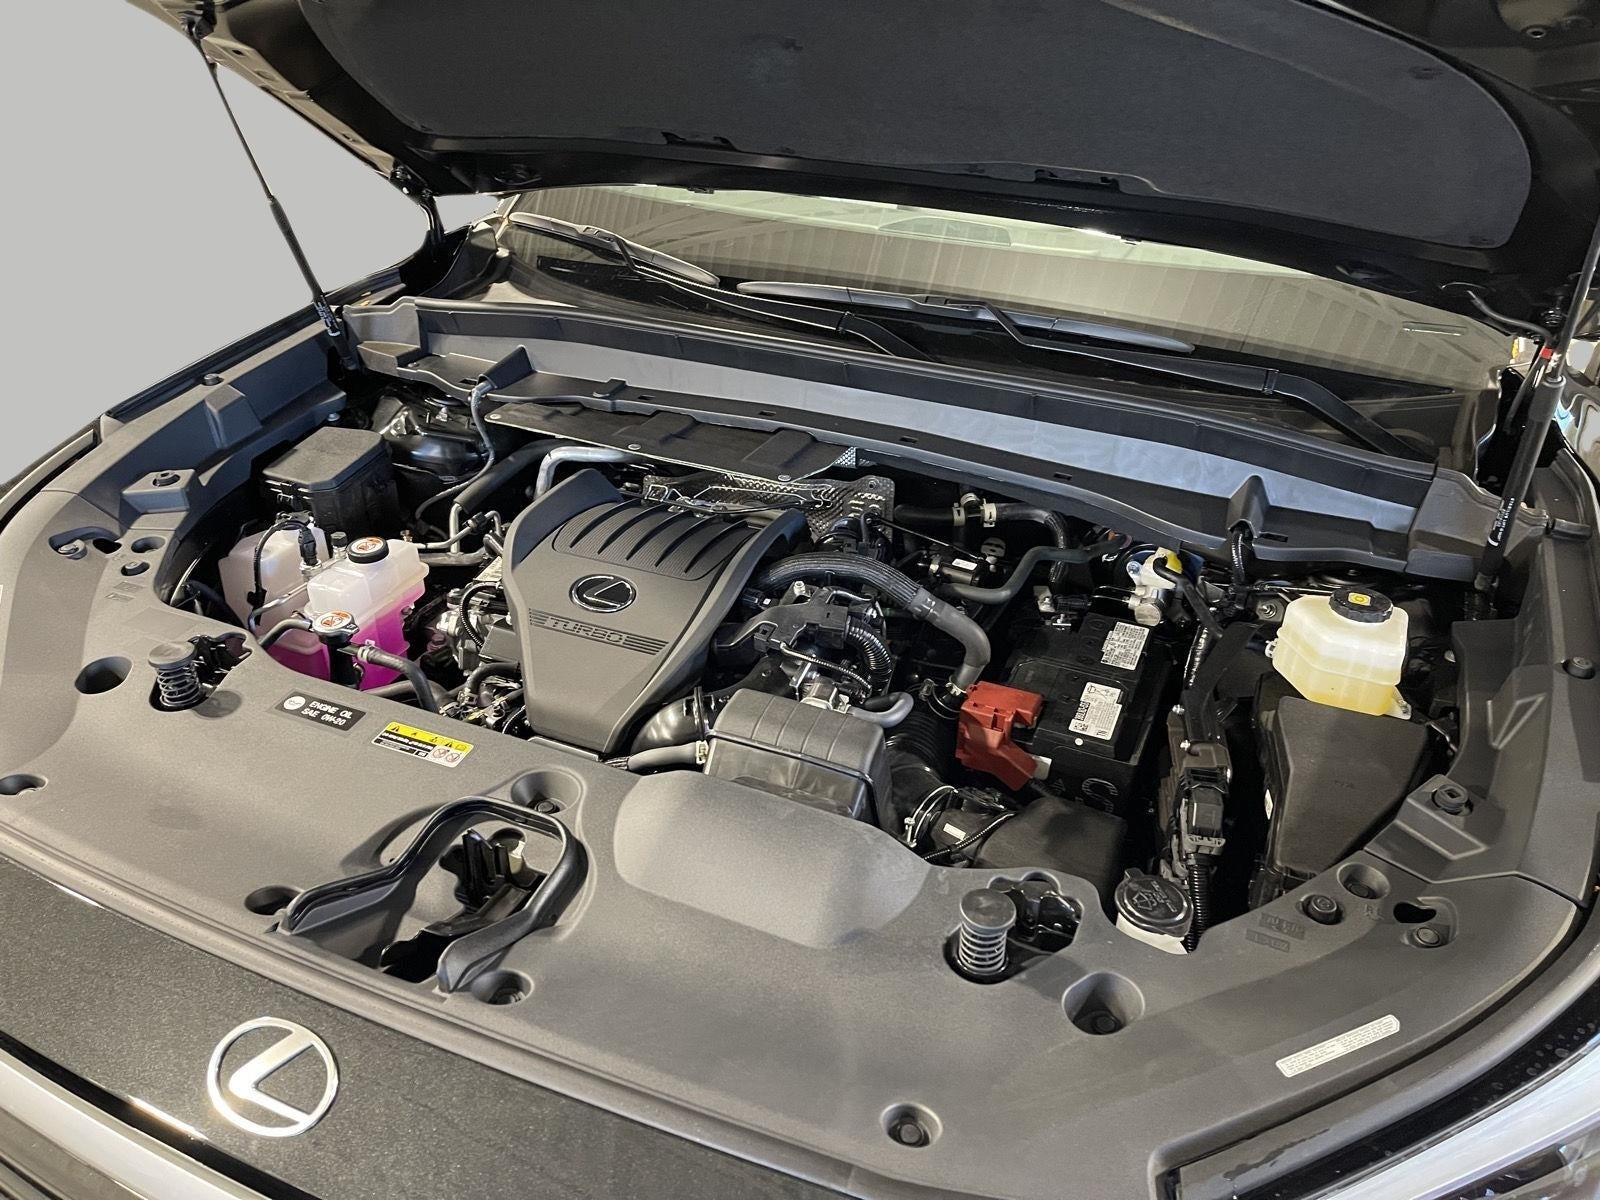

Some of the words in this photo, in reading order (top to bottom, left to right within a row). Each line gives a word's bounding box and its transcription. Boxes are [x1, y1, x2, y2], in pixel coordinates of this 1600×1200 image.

[550, 617, 623, 643] TURBO
[301, 708, 320, 718] SAE
[320, 713, 347, 726] 0W-20
[309, 701, 339, 714] ENGINE
[339, 710, 353, 719] OIL
